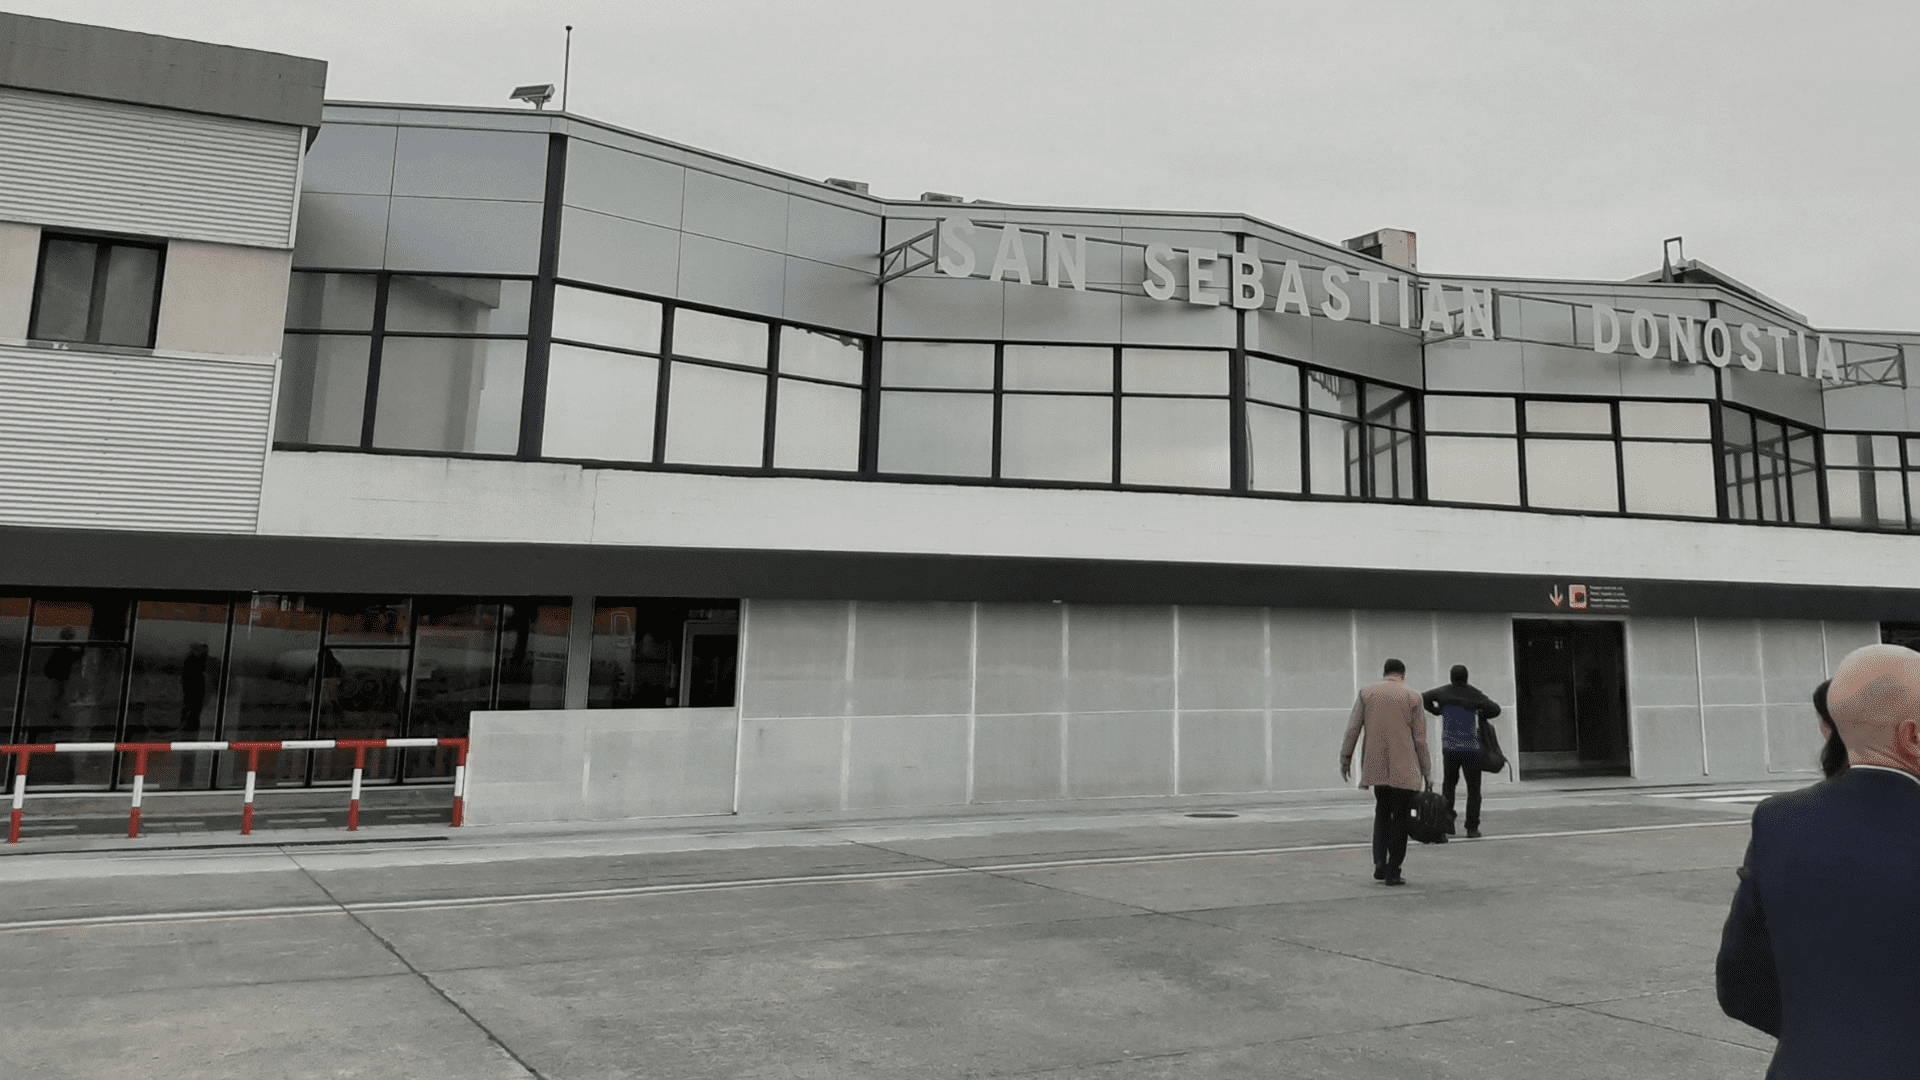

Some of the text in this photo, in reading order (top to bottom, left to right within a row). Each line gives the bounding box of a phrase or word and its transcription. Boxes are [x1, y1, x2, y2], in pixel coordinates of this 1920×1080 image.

[938, 217, 1840, 382] SAN SEBASTIAN DONOSTIA
